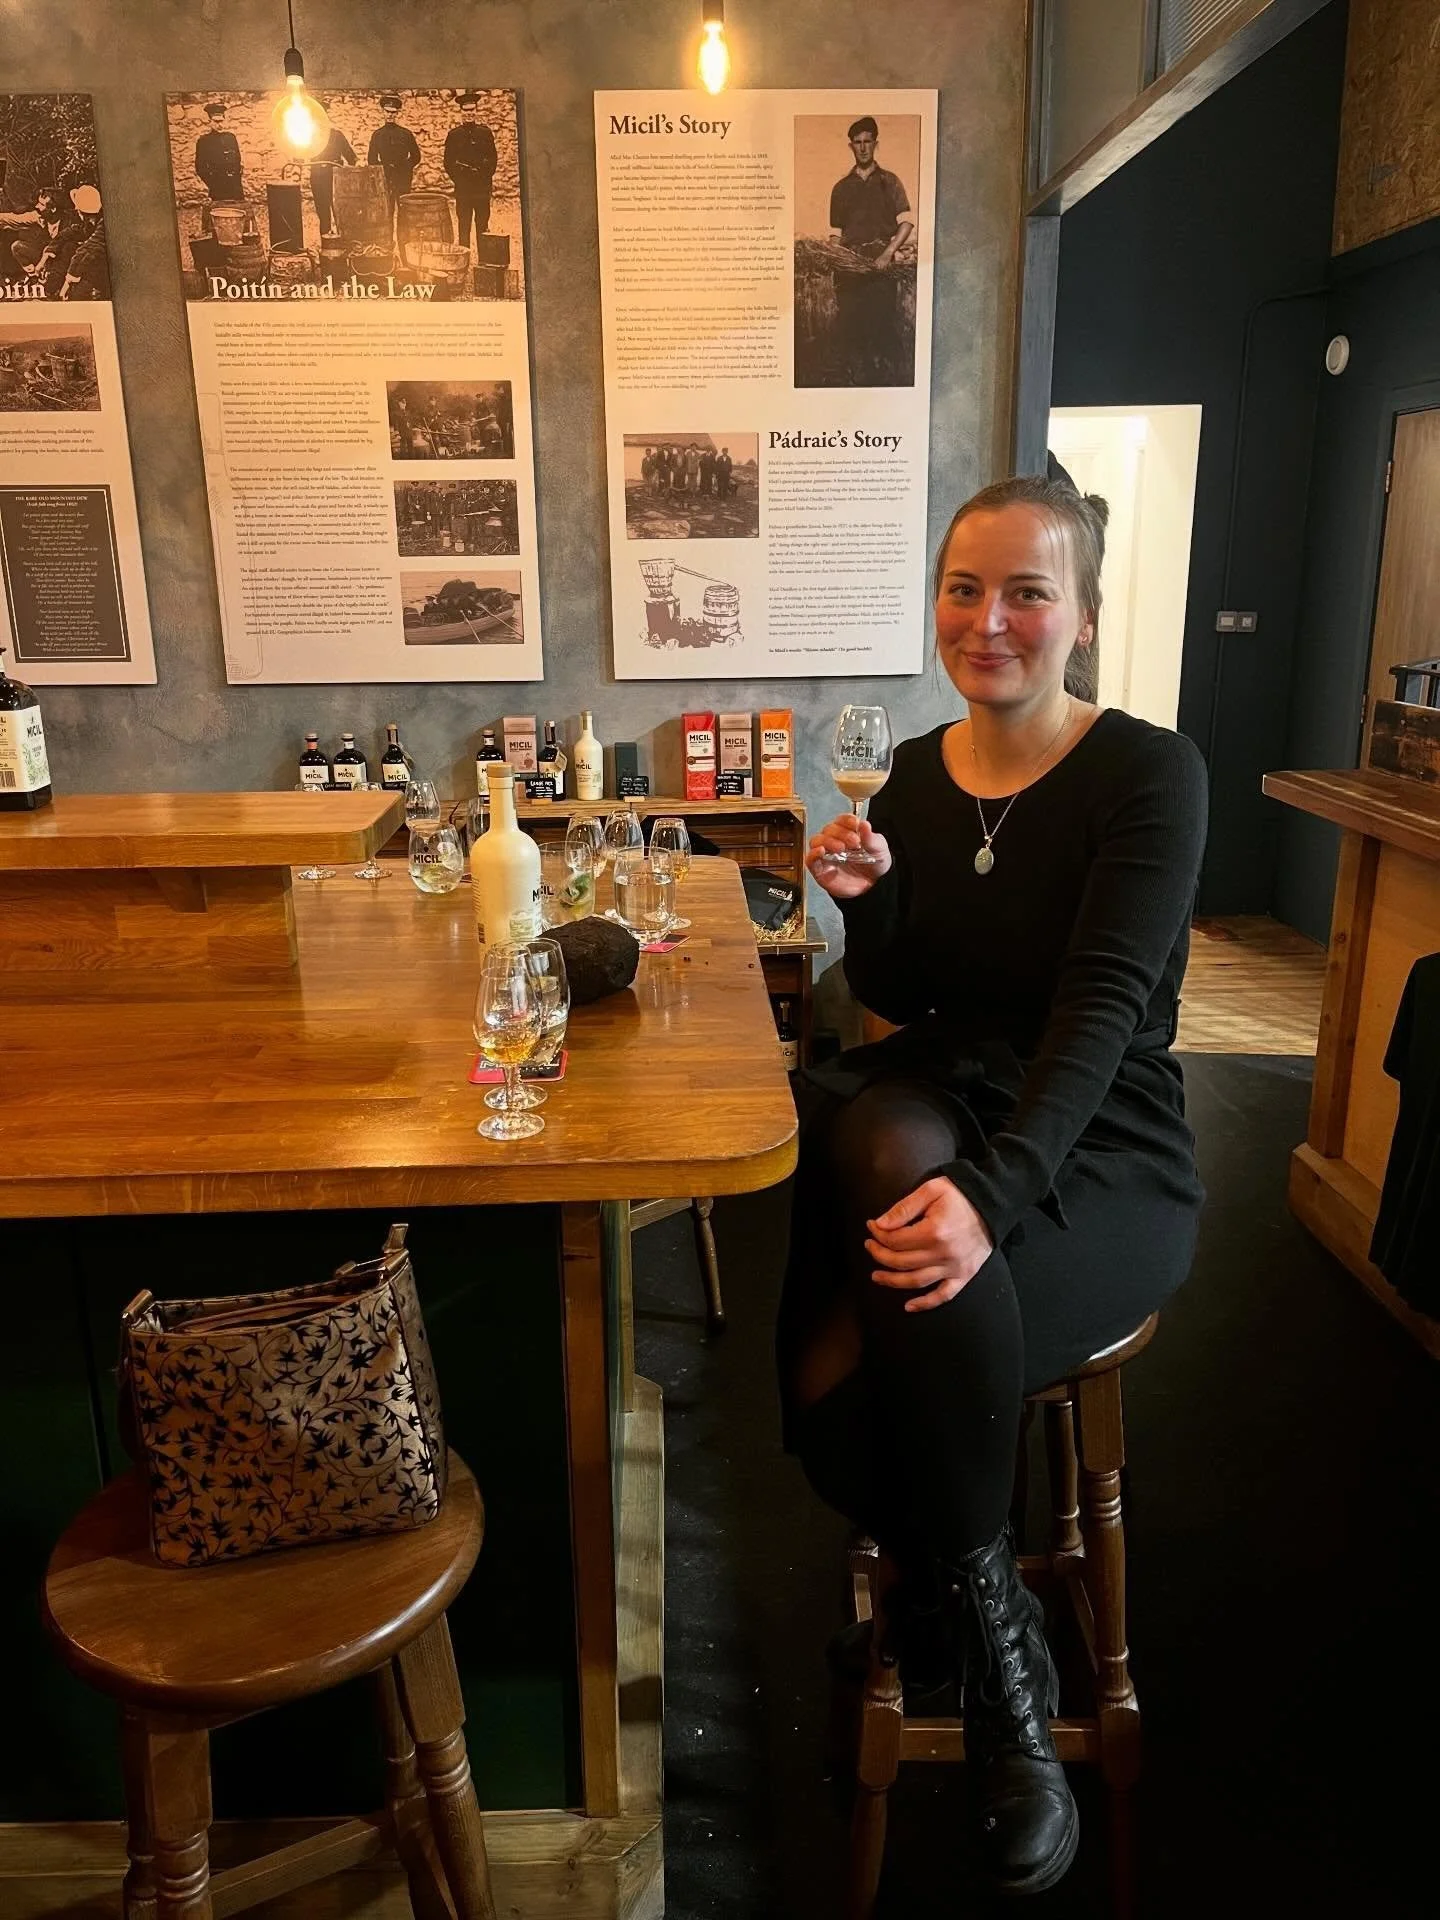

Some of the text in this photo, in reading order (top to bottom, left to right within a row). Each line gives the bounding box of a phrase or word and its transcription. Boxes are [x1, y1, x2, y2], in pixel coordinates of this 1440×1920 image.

[609, 113, 732, 140] Micil’s Story
[210, 275, 437, 299] Poitín and the Law
[768, 430, 903, 452] Pádraic’s Story
[413, 854, 443, 864] MICIL
